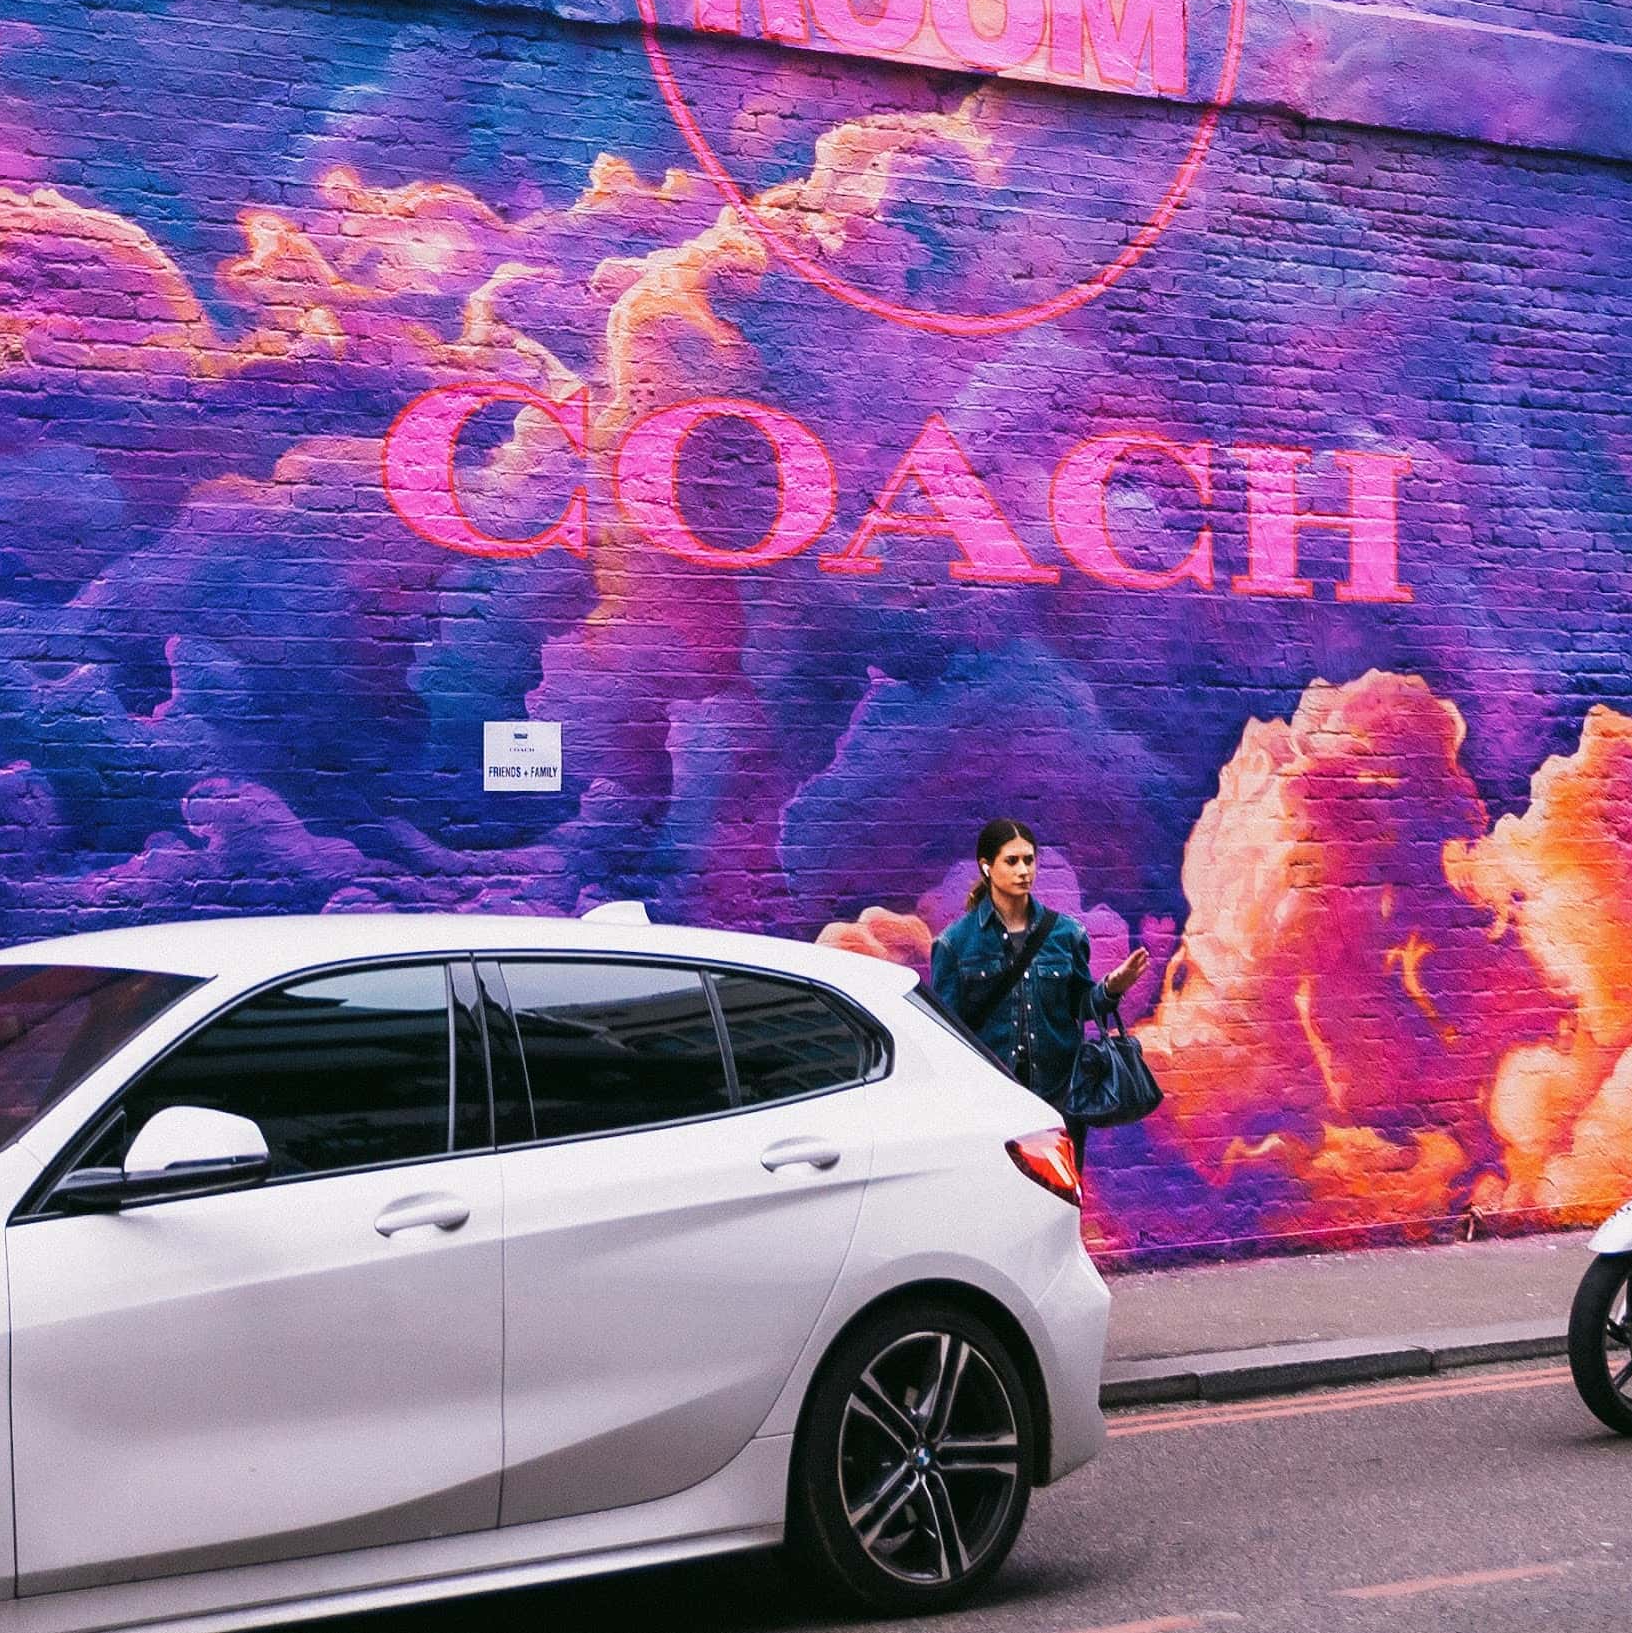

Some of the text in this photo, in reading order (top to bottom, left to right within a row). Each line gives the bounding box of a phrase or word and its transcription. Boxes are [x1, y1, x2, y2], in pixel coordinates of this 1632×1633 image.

[380, 380, 1415, 605] COACH
[488, 766, 521, 778] FRIENDS
[530, 766, 558, 778] FAMILY
